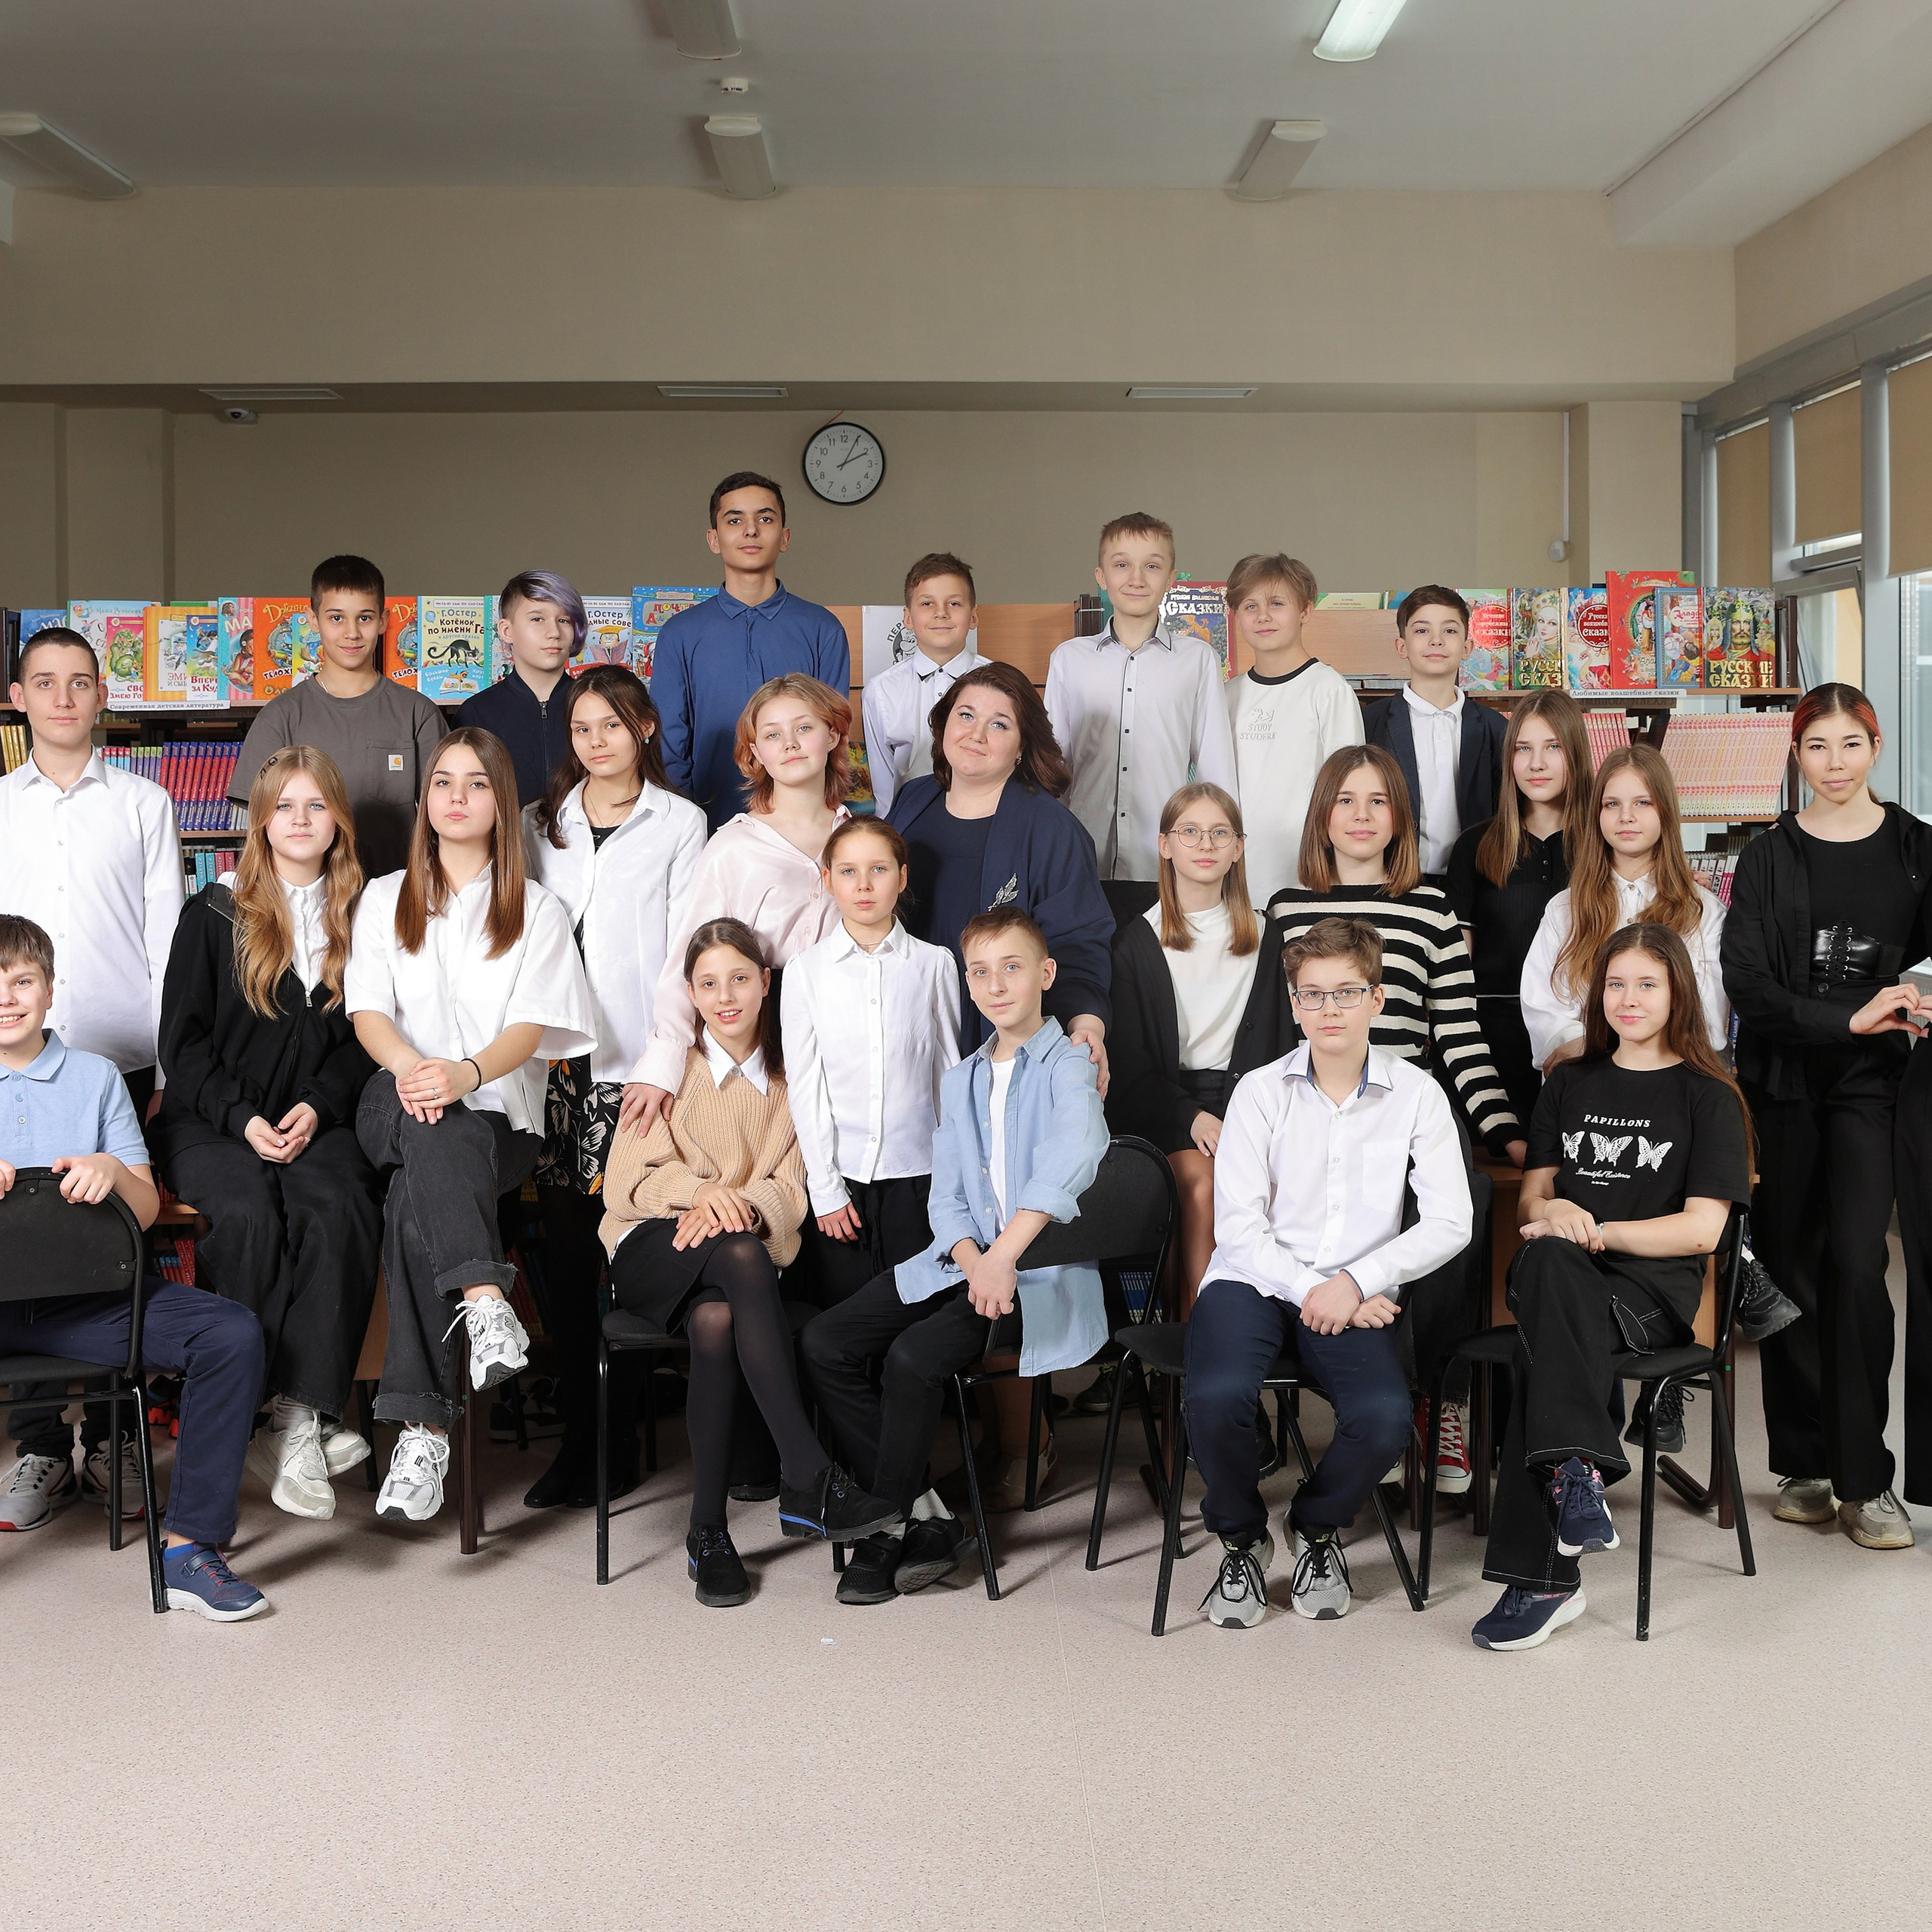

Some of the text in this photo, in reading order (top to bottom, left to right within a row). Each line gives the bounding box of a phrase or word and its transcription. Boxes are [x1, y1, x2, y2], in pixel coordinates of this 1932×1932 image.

[840, 435, 848, 443] 12
[816, 460, 821, 468] 9
[867, 460, 873, 468] 3
[439, 617, 475, 626] Котёнок
[887, 620, 903, 642] ПЕР
[1247, 723, 1272, 732] STUDY
[1583, 1114, 1651, 1128] PAPILLONS
